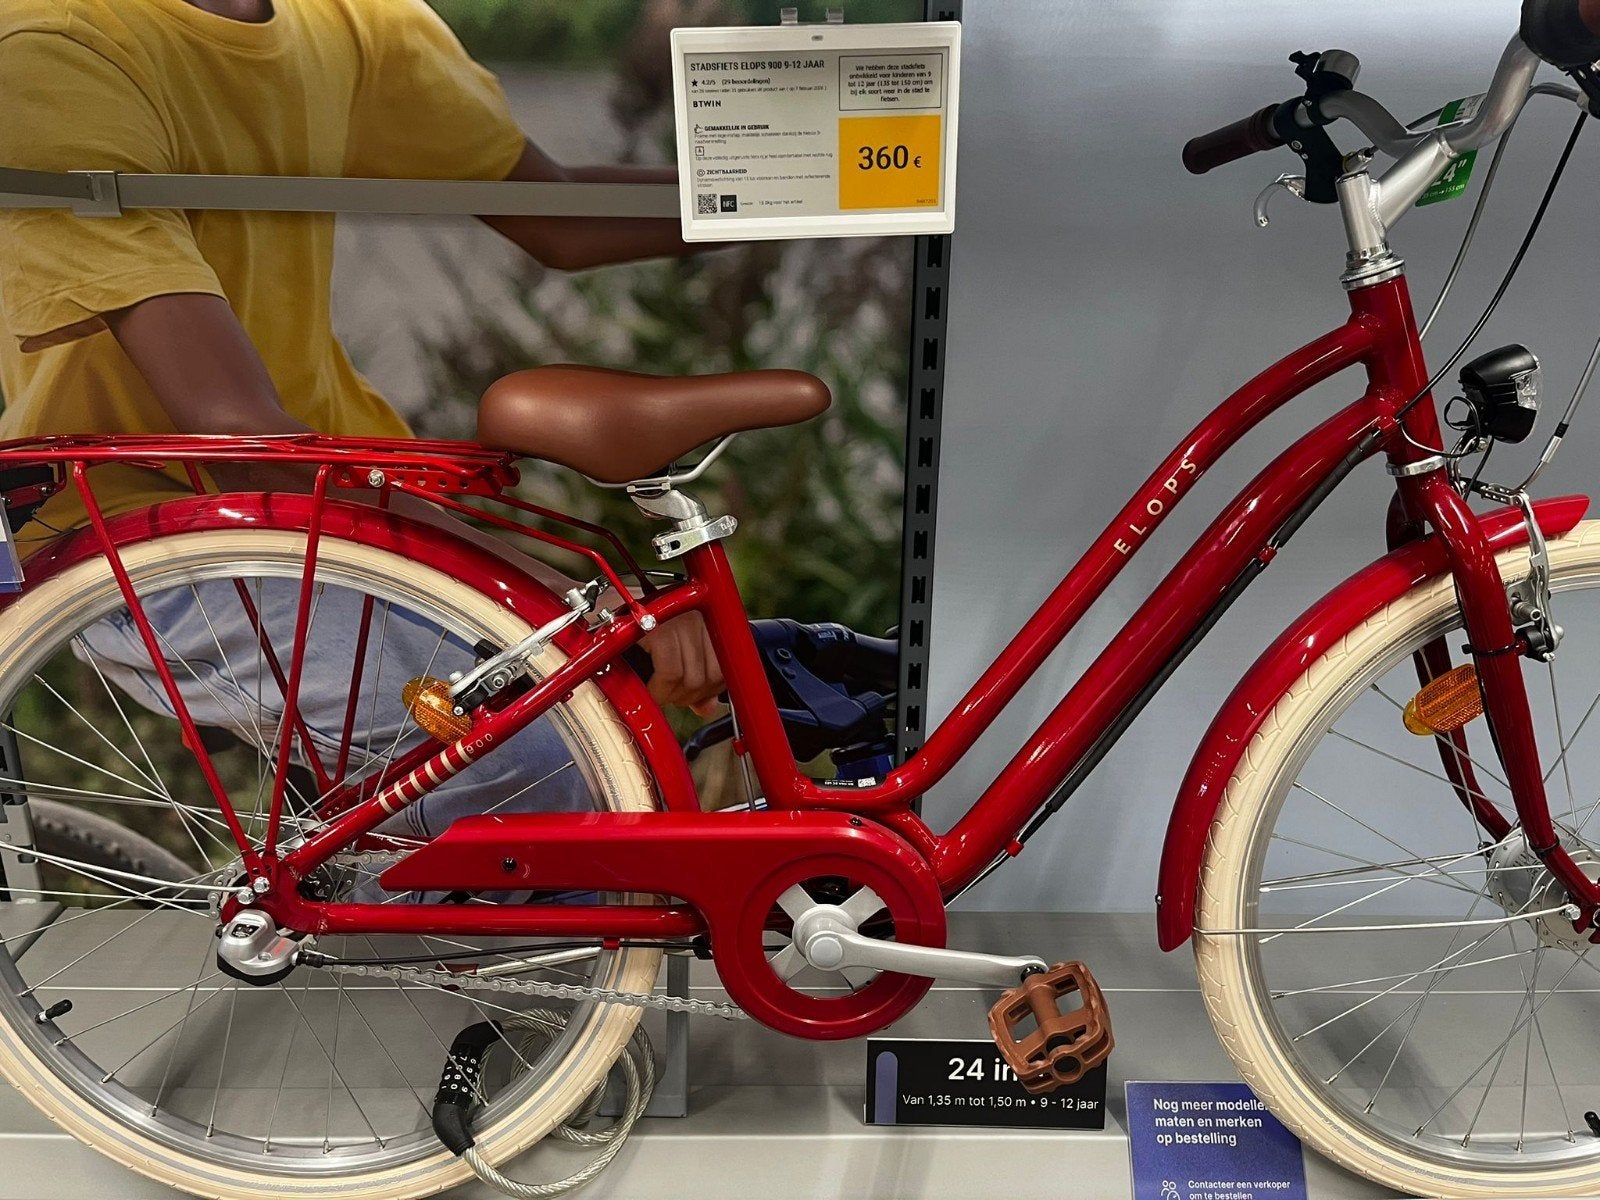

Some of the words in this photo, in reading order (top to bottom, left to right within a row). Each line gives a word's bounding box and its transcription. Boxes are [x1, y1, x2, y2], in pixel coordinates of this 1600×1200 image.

[690, 61, 739, 71] STADSFIETS
[741, 61, 766, 70] ELOPS
[768, 60, 782, 70] 900
[784, 60, 801, 69] 9-12
[803, 60, 825, 68] JAAR
[900, 62, 926, 70] stadsfiets
[865, 81, 876, 89] jaar
[858, 145, 909, 170] 360
[913, 155, 922, 169] €
[1113, 458, 1197, 555] ELOPS
[466, 733, 493, 754] 900
[948, 1058, 985, 1081] 24
[994, 1058, 1018, 1081] in
[902, 1094, 925, 1105] Van
[928, 1095, 951, 1107] 1,35
[955, 1097, 966, 1106] m
[969, 1096, 985, 1106] tot
[989, 1097, 1012, 1108] 1,50
[1015, 1098, 1027, 1107] m
[1040, 1097, 1048, 1108] 9
[1060, 1098, 1074, 1109] 12
[1076, 1099, 1099, 1112] jaar
[1153, 1099, 1179, 1113] Nog
[1181, 1100, 1213, 1111] meer
[1216, 1099, 1268, 1111] modelle
[1155, 1117, 1195, 1127] maten
[1197, 1118, 1213, 1127] en
[1215, 1116, 1262, 1127] merken
[1156, 1134, 1173, 1146] op
[1175, 1132, 1237, 1147] bestelling
[1188, 1180, 1234, 1189] Contacteer
[1254, 1180, 1291, 1191] verkoper
[1204, 1192, 1213, 1200] te
[1215, 1191, 1253, 1200] bestellen
